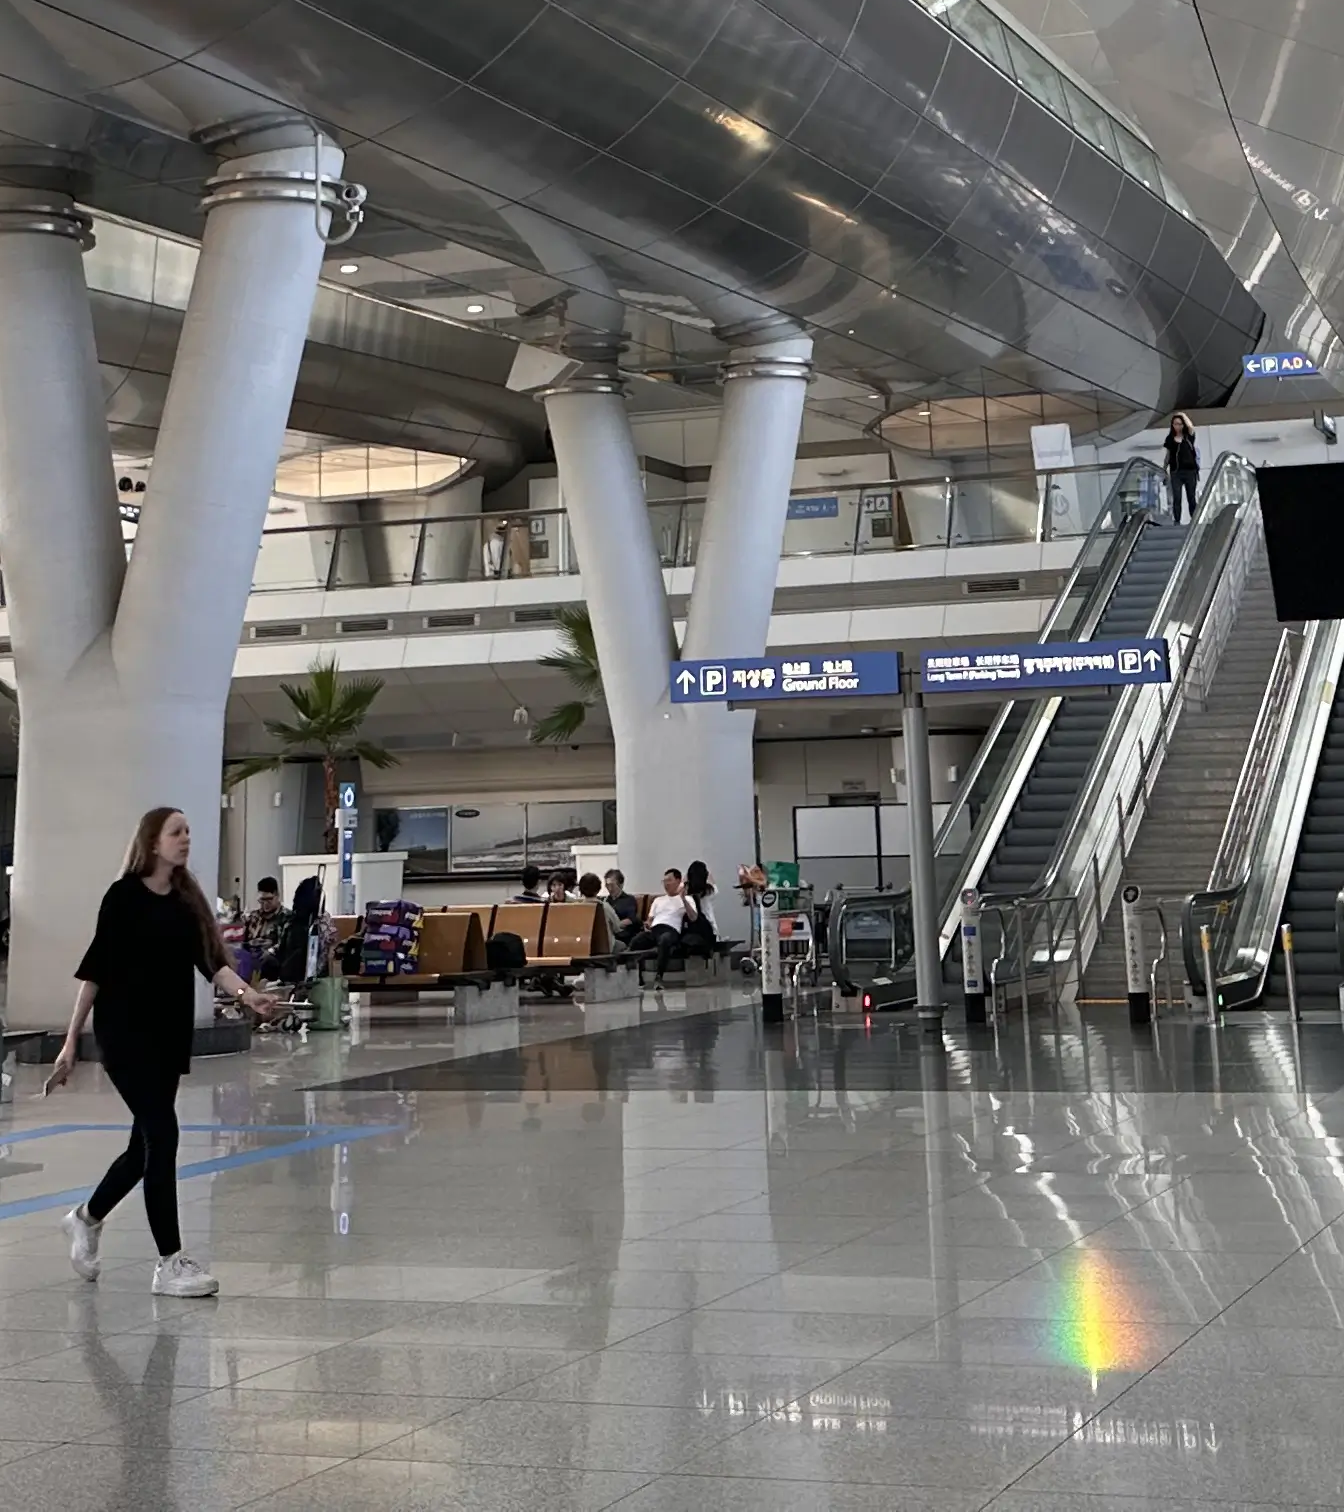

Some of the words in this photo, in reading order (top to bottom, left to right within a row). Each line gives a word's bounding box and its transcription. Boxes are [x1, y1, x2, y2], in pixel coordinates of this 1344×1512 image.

[782, 676, 827, 692] Ground
[828, 675, 860, 689] Floor
[927, 672, 945, 683] Long
